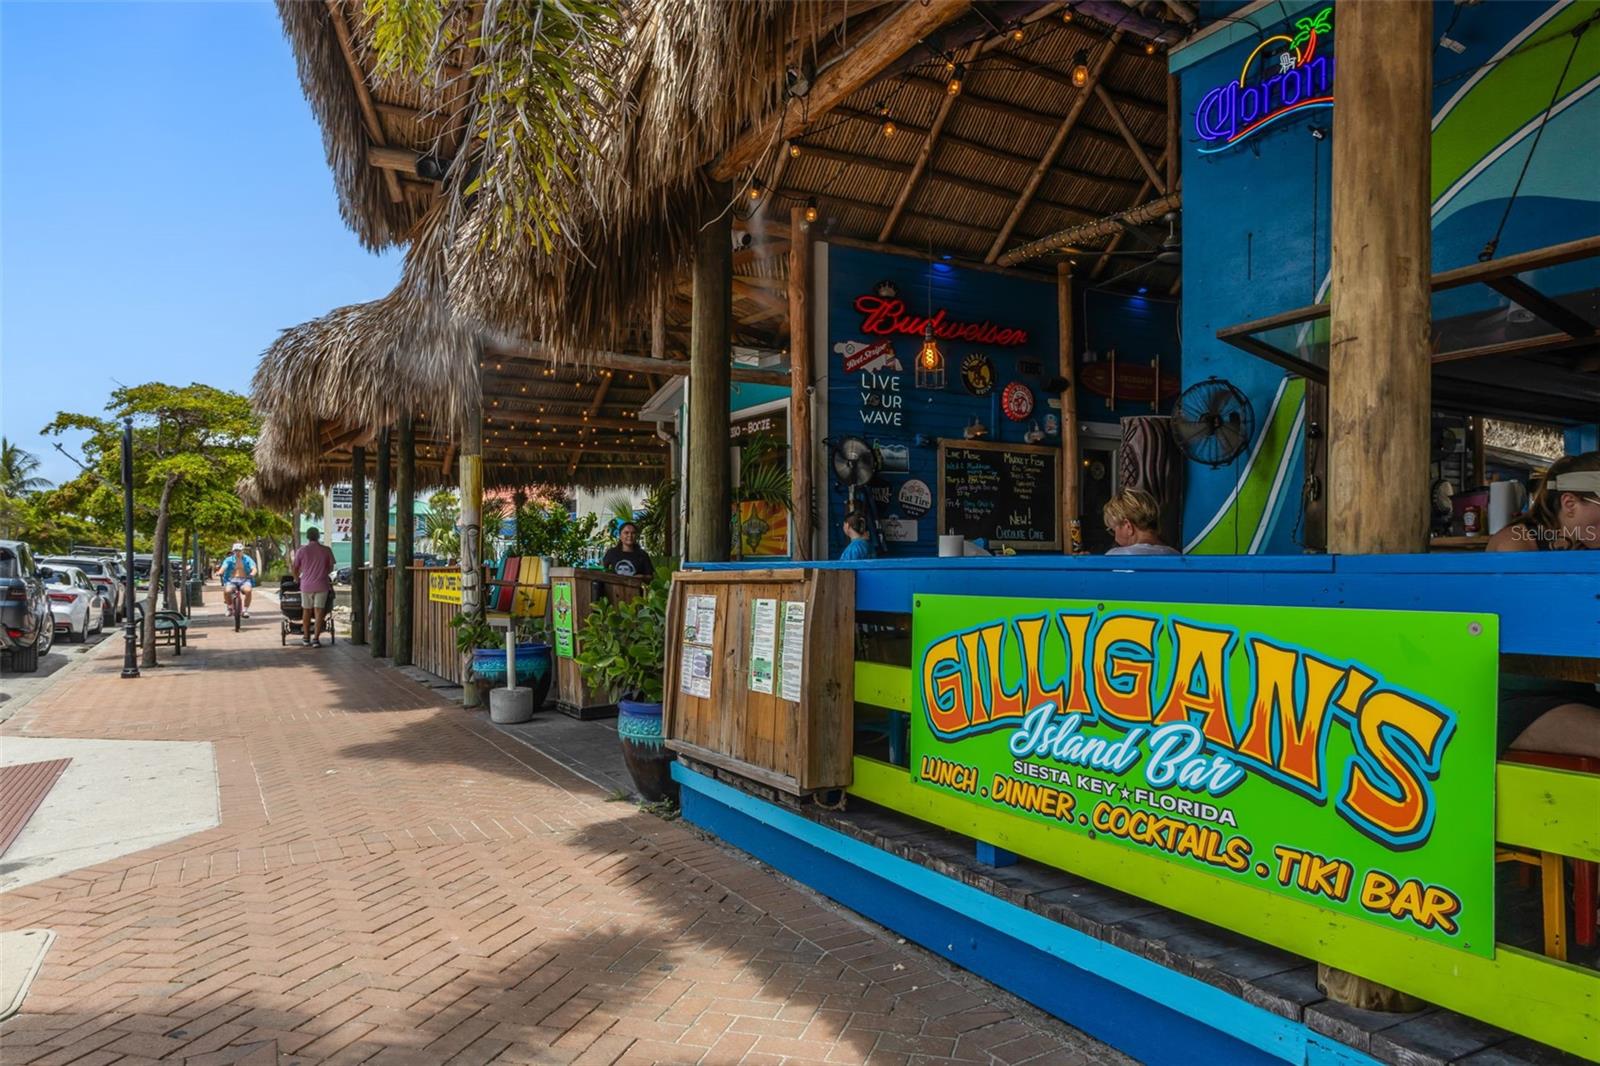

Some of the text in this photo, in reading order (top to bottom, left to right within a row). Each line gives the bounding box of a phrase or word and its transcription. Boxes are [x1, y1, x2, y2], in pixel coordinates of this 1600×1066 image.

[1195, 56, 1336, 140] Coron
[854, 295, 1028, 345] Budweiser
[859, 410, 902, 426] WAVE
[861, 373, 900, 391] LIVE
[920, 609, 1454, 848] GILLIGAN'S
[1009, 701, 1244, 794] Island Bar
[1012, 760, 1236, 827] SIESTA KEY FLORIDA
[920, 756, 1460, 932] LUNCH DINNER COCKTAILS TIKI BAR
